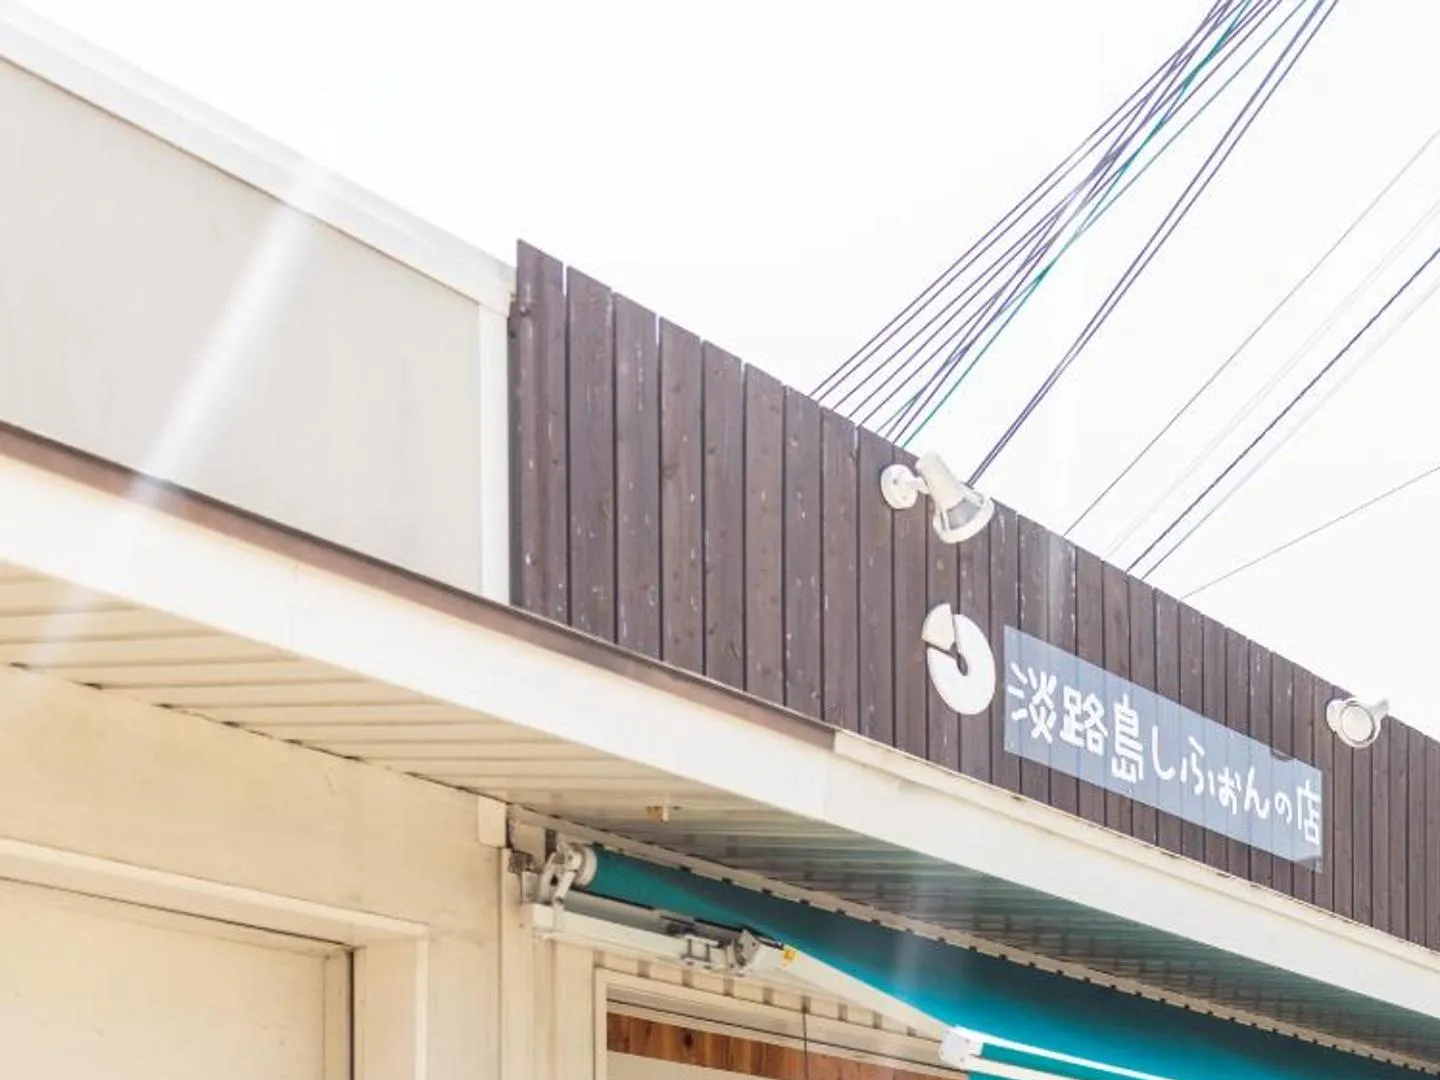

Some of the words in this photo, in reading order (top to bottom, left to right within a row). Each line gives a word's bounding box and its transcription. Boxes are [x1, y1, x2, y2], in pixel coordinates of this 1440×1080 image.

[1006, 660, 1323, 847] 淡路島しふぉんの店
